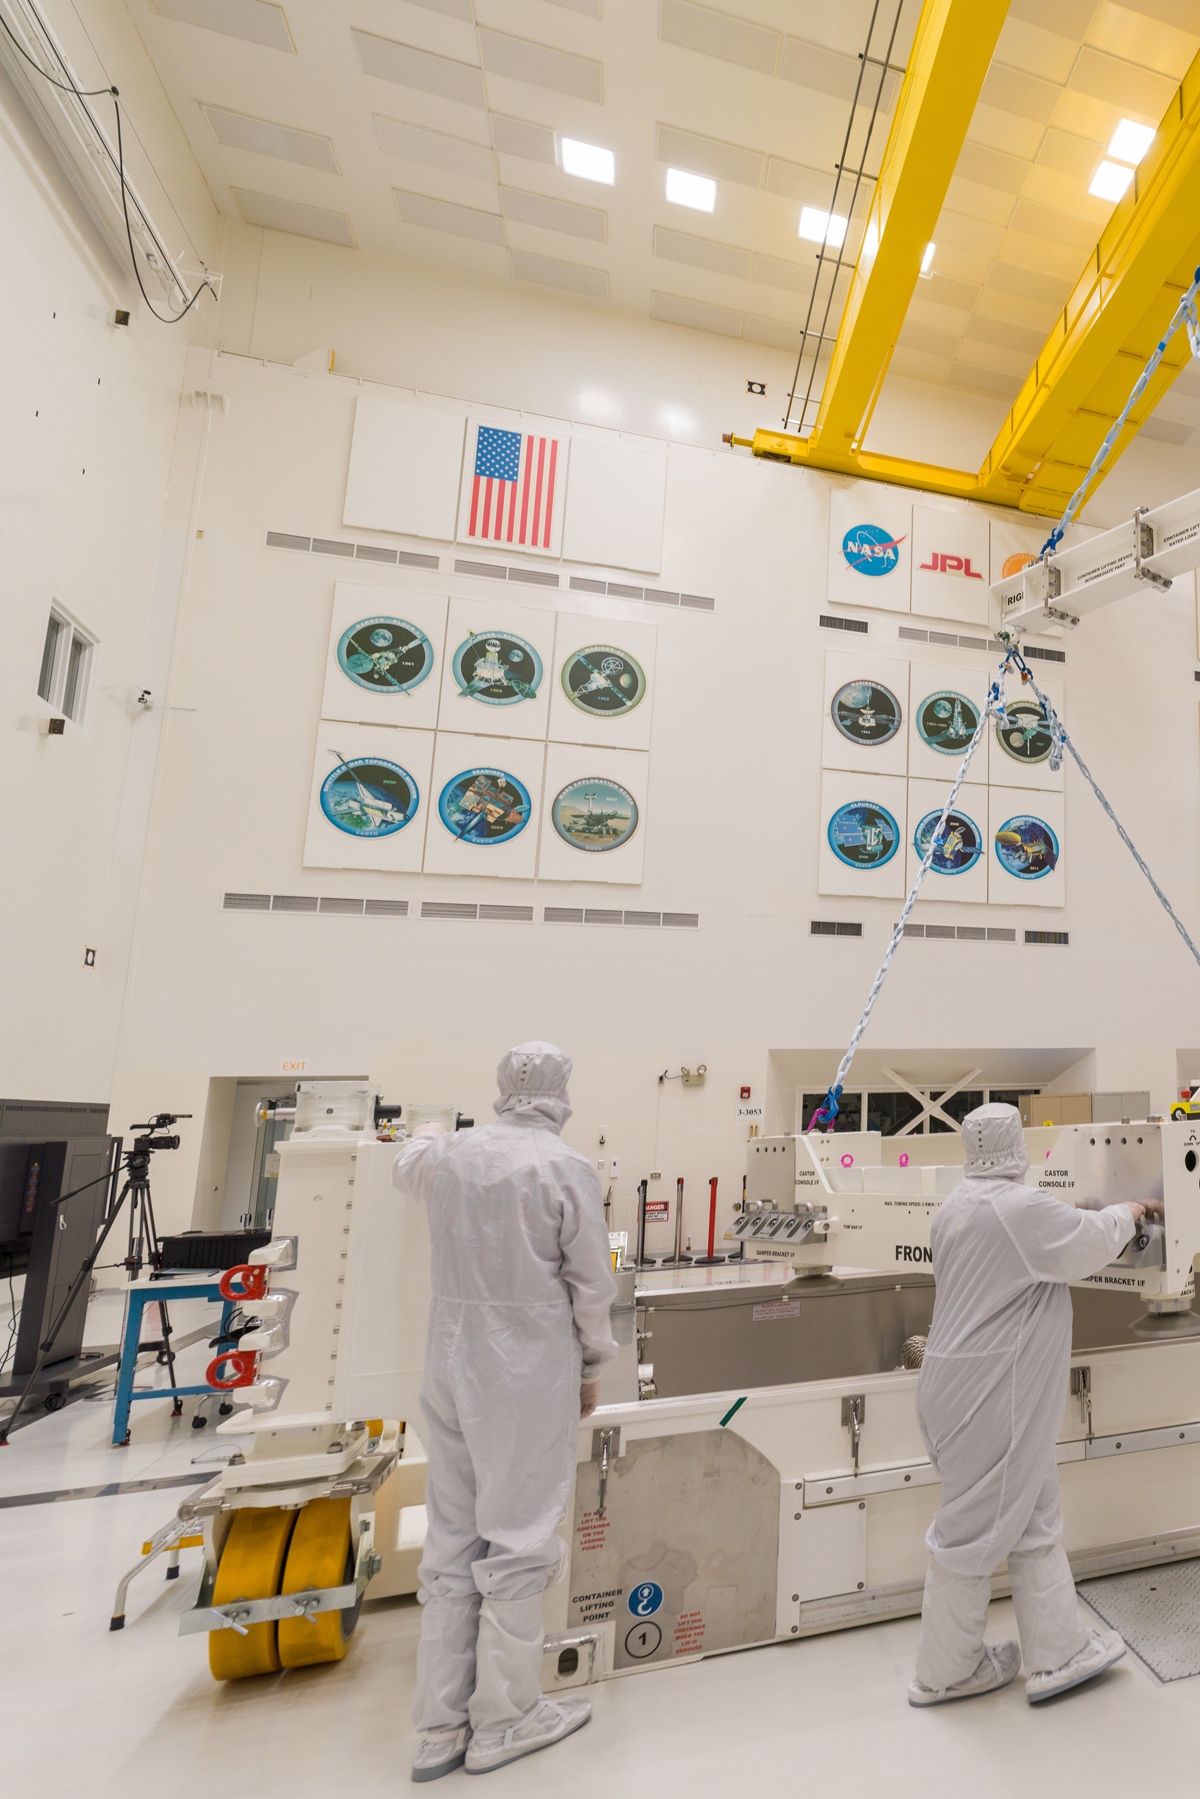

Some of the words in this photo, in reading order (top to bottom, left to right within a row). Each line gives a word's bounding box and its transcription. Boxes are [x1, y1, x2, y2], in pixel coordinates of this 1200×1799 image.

[1163, 525, 1189, 543] CONTAINER
[1169, 537, 1184, 547] RATED
[1185, 531, 1199, 541] LOAD:
[847, 541, 896, 560] NASA
[919, 552, 983, 579] JPL
[1077, 568, 1100, 581] CONTAINER
[1100, 559, 1117, 571] LIFTING
[1117, 552, 1133, 563] DEVICE
[1084, 568, 1114, 584] INTERMEDIATE
[1114, 562, 1126, 571] PART
[1007, 592, 1024, 606] RIG
[355, 618, 384, 629] RANGER
[393, 619, 416, 632] BLOCK
[503, 634, 525, 645] BLOCK
[472, 769, 505, 777] SEAWINDS
[323, 769, 341, 792] SHUTTLE
[341, 760, 363, 771] RDAR
[364, 759, 407, 777] TOPOGRAPHY
[405, 776, 417, 799] MISSION
[558, 785, 573, 800] MARS
[573, 778, 619, 789] EXPLORATION
[619, 787, 635, 806] ROVER
[850, 802, 879, 810] CLOUDSAT
[283, 1062, 307, 1070] EXIT
[737, 1108, 762, 1116] 3-3053
[1039, 1180, 1067, 1188] CONSOLE
[895, 1245, 932, 1263] FRON
[1104, 1276, 1135, 1286] BRACKET
[1137, 1279, 1146, 1287] I/F
[1180, 1288, 1193, 1296] JACK
[577, 1523, 610, 1532] CONTAINER
[580, 1537, 606, 1545] LASHING
[581, 1544, 604, 1552] POINTS
[572, 1589, 623, 1604] CONTAINER
[580, 1600, 615, 1612] LIFTING
[583, 1612, 610, 1622] POINT
[674, 1624, 706, 1634] CONTAINER
[638, 1632, 647, 1646] 1
[676, 1645, 703, 1654] REMOVED
